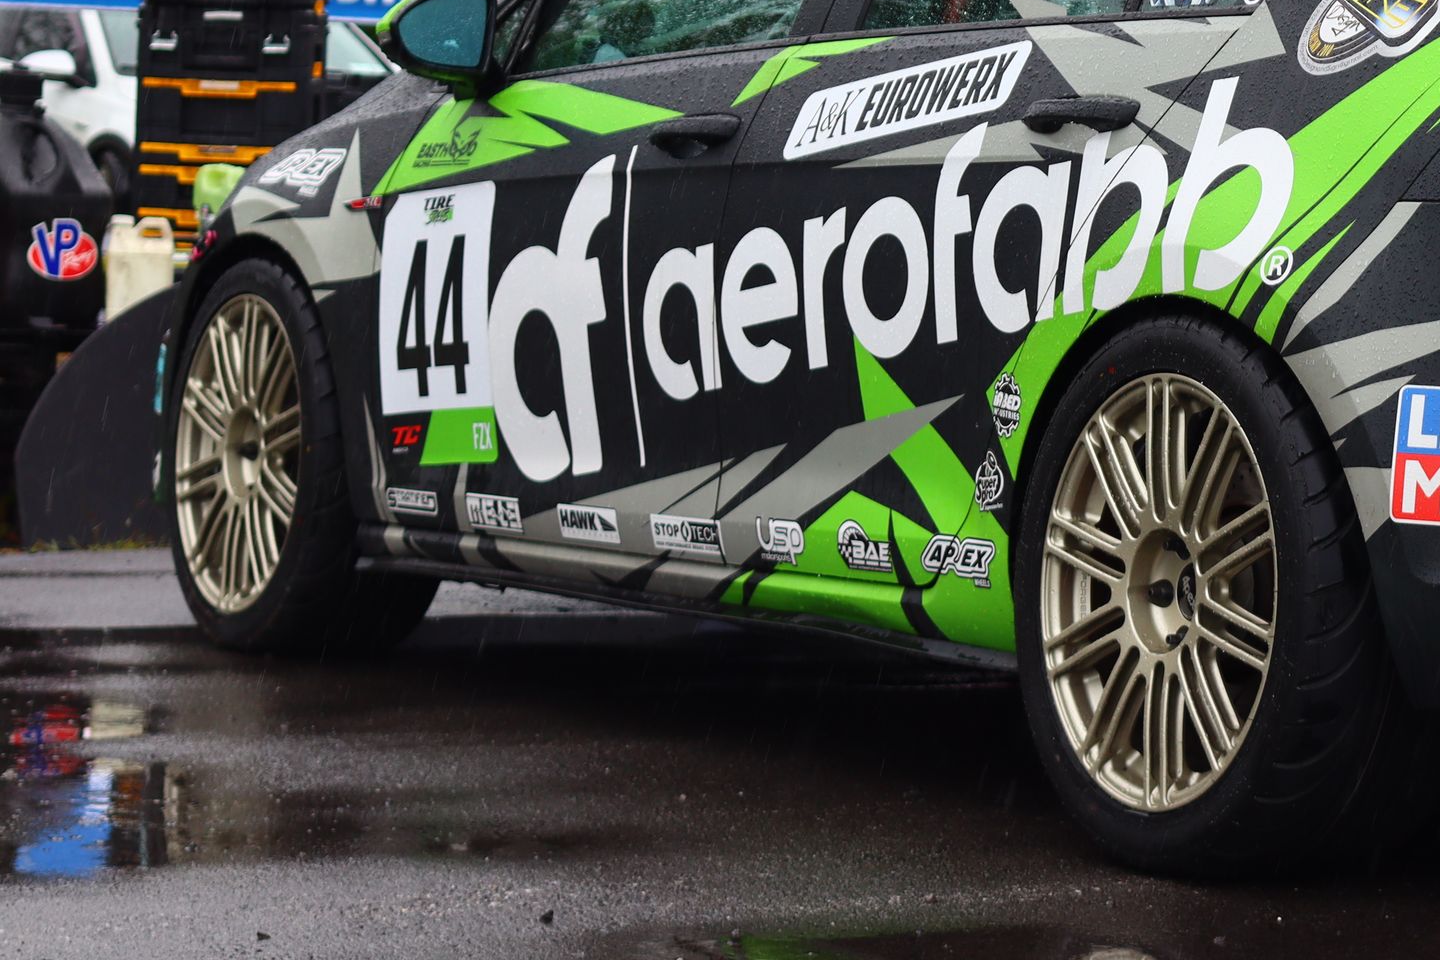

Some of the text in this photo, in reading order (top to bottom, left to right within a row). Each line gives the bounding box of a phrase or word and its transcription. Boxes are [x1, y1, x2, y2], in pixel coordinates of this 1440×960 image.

[794, 50, 1018, 148] A&K EUROWERX
[423, 194, 456, 211] TIRE
[35, 220, 80, 277] VP
[397, 234, 470, 397] 44
[391, 424, 422, 446] TC
[559, 508, 597, 531] HAWK
[654, 520, 680, 537] STOP
[851, 539, 890, 562] BAE
[927, 542, 989, 570] APEX
